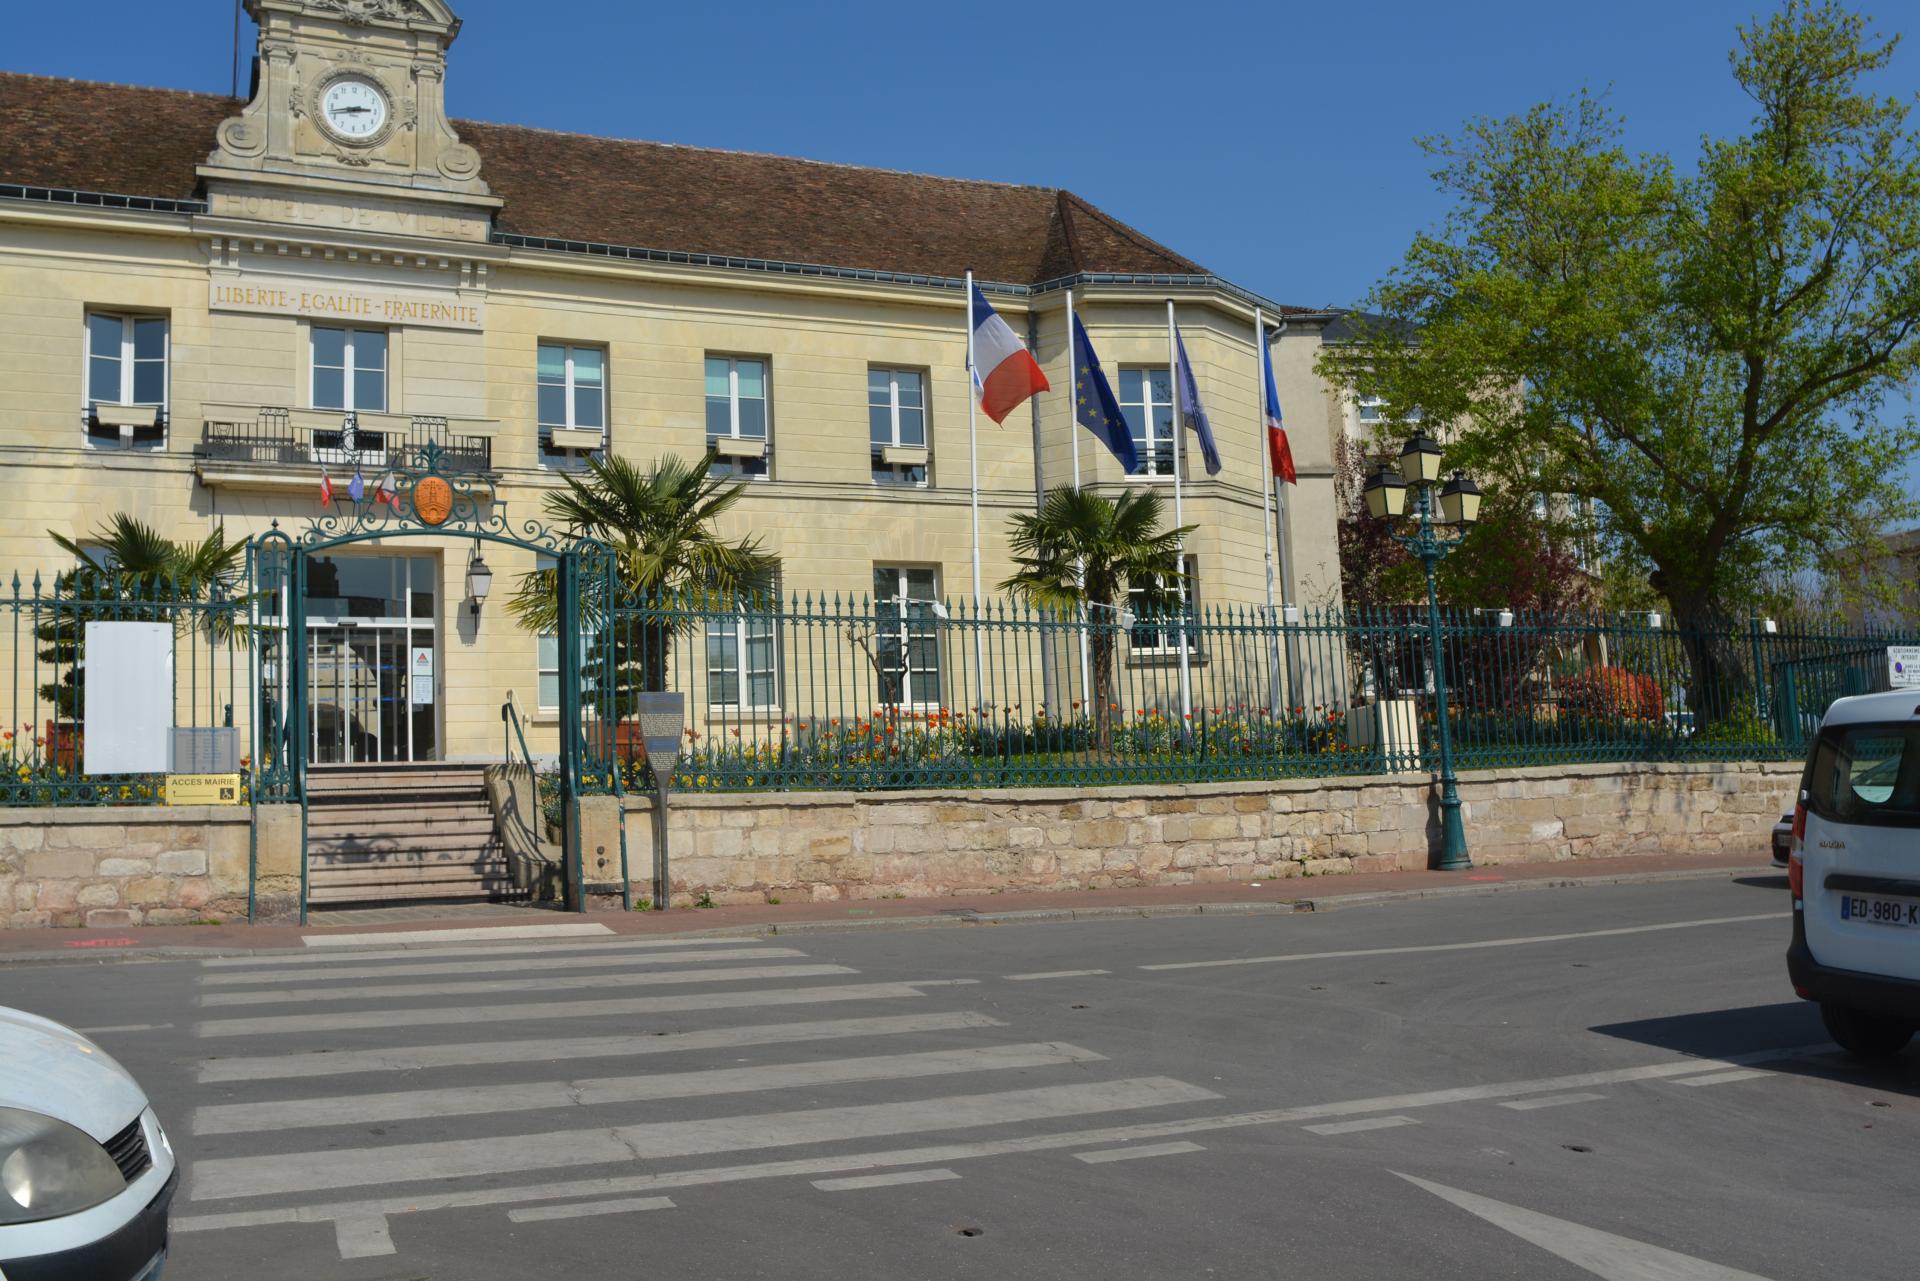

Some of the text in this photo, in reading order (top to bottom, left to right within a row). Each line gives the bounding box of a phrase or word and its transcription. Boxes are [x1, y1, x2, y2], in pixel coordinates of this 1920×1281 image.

[342, 206, 373, 226] DE
[394, 210, 473, 236] VILLE
[204, 778, 235, 786] MAIRIE
